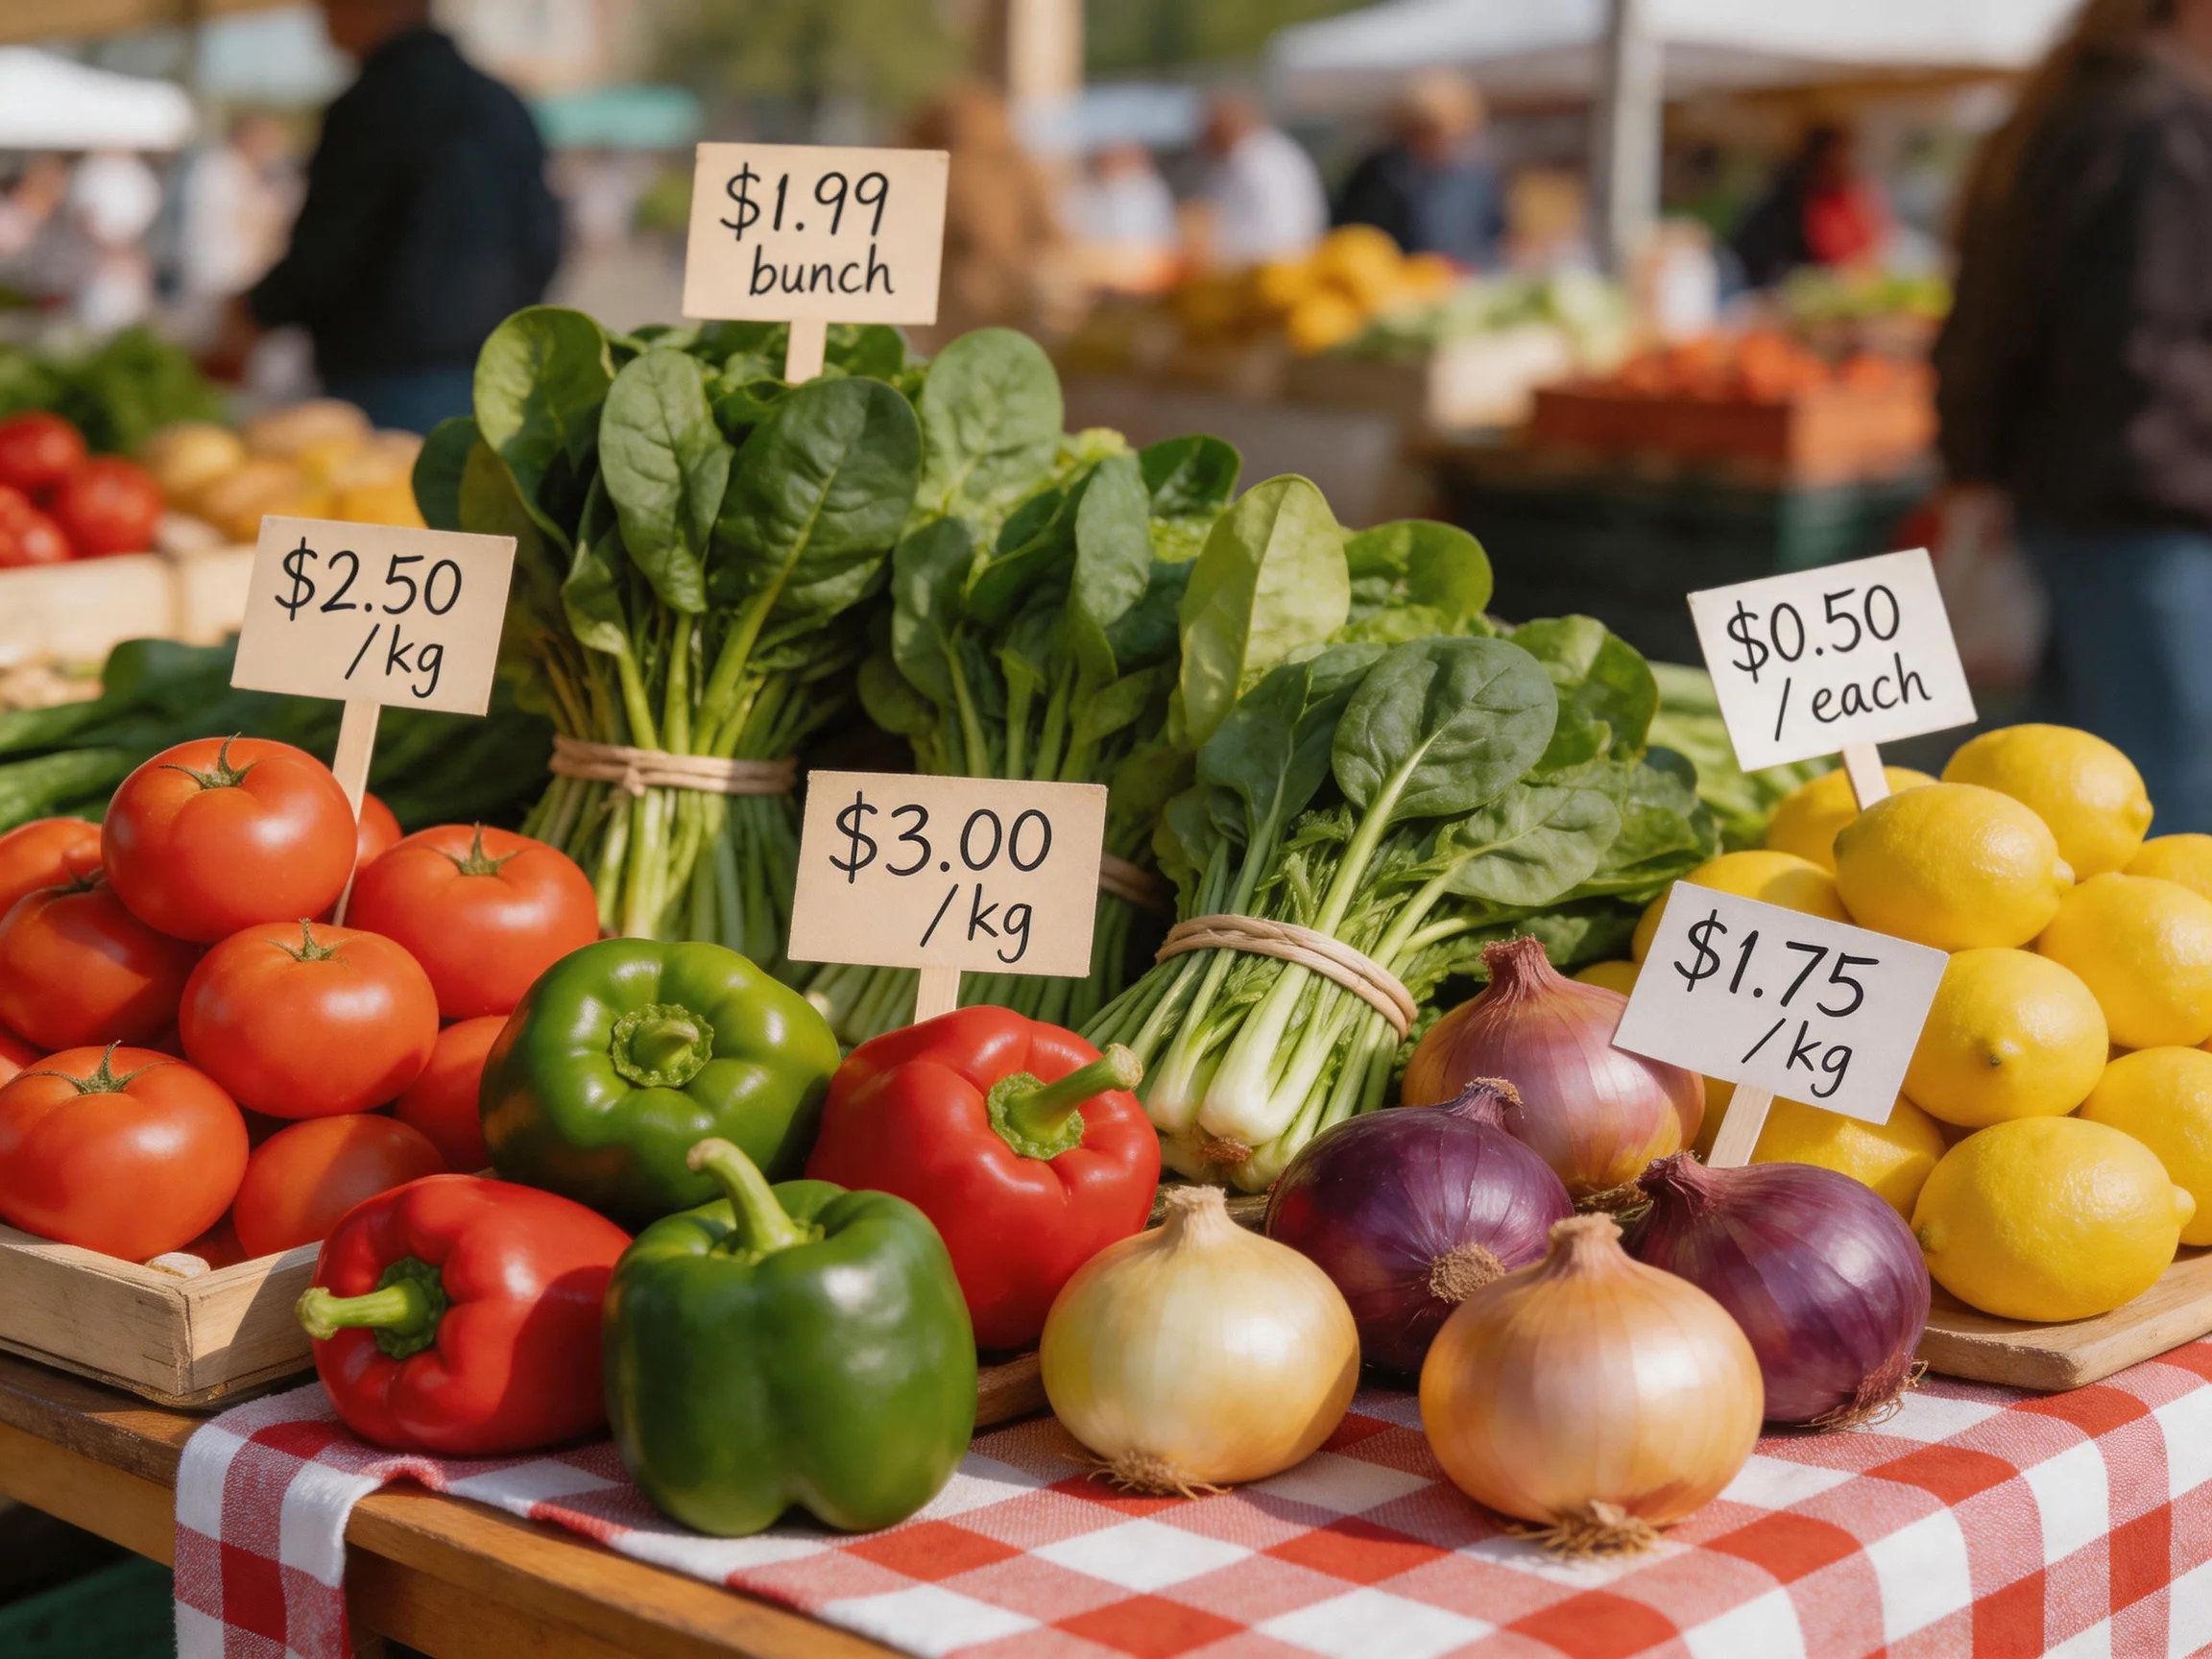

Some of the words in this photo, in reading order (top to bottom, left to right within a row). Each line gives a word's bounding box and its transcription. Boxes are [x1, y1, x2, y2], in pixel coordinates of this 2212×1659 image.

[720, 162, 889, 242] $1.99
[749, 243, 894, 297] bunch
[275, 536, 462, 622] $2.50
[1727, 585, 1900, 684] $0.50
[829, 790, 1052, 884] $3.00
[1673, 908, 1880, 1018] $1.75
